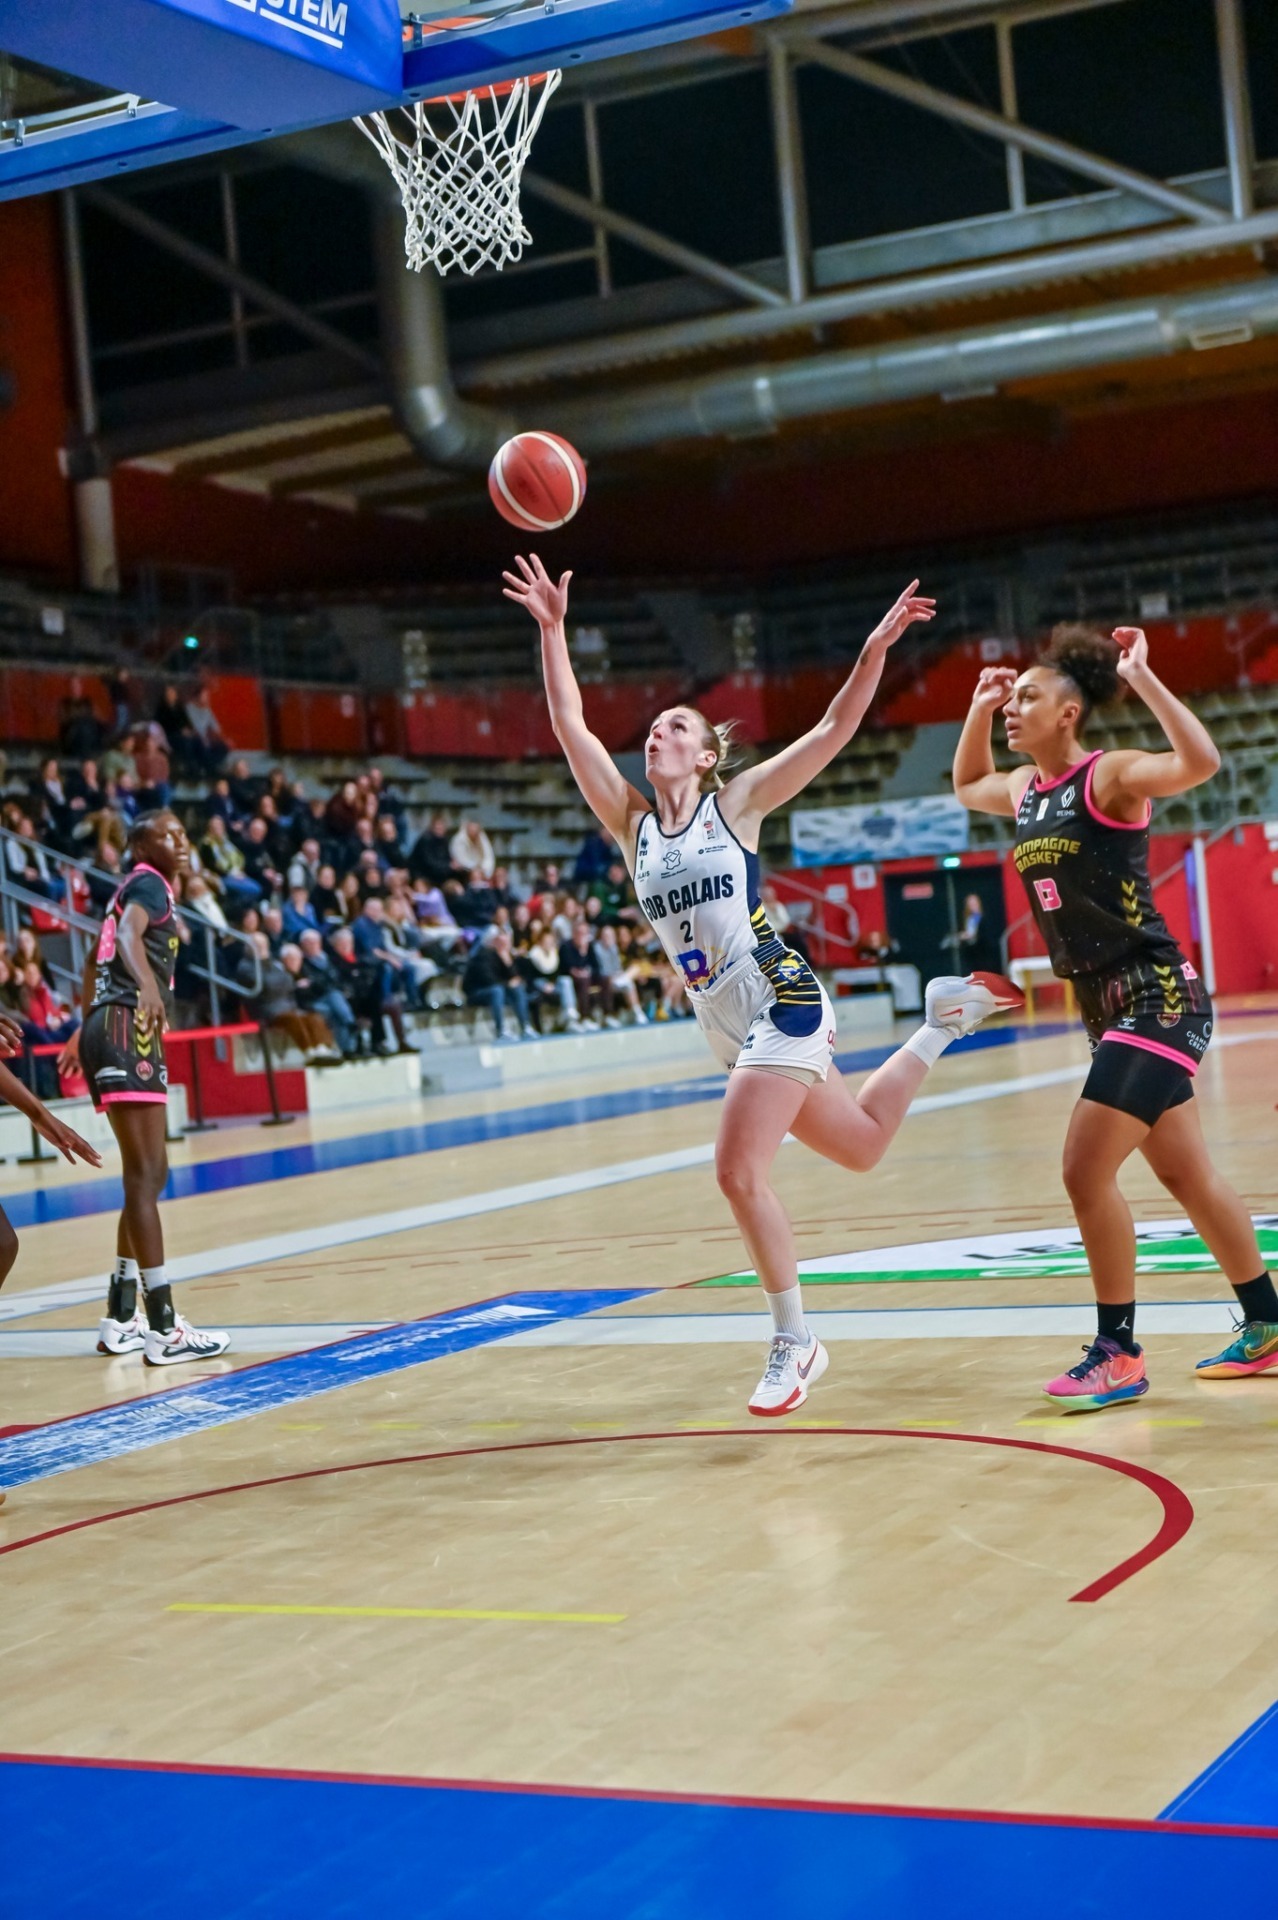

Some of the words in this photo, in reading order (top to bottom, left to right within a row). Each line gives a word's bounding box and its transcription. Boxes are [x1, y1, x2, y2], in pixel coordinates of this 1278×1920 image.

[1016, 851, 1062, 873] BASKET
[667, 873, 734, 914] CALAIS
[680, 920, 694, 944] 2
